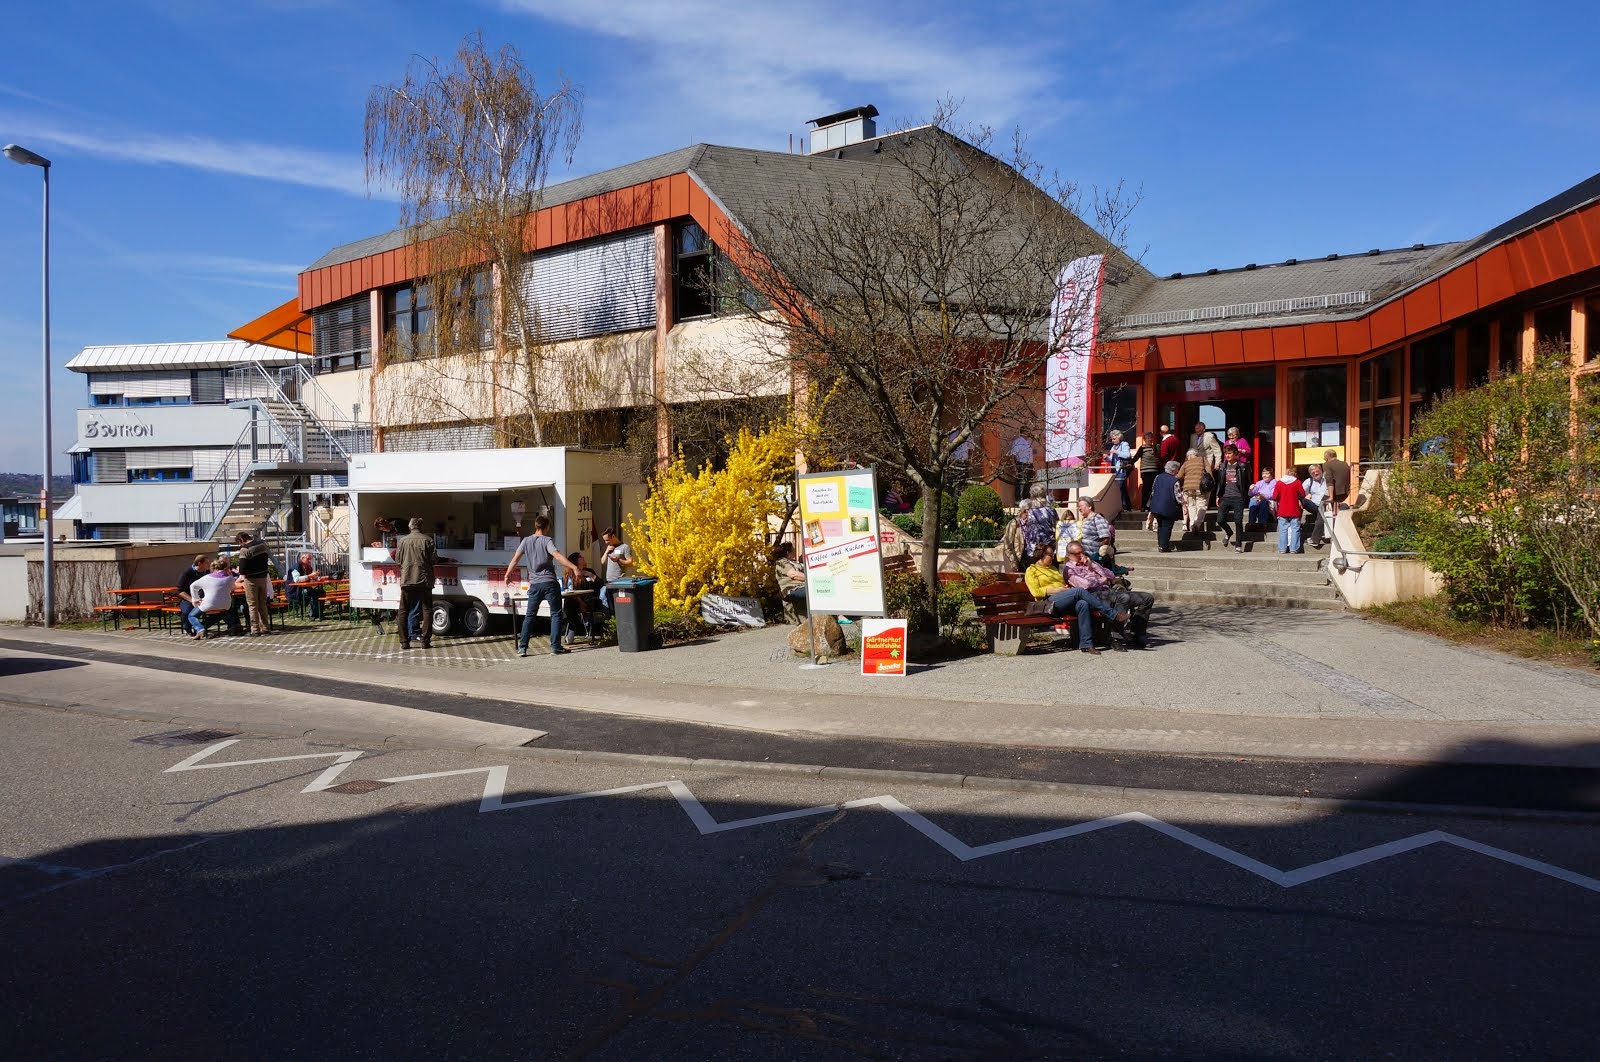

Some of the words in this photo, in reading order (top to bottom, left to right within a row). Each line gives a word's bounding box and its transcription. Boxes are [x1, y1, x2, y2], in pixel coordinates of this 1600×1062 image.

[1054, 375, 1069, 403] der
[102, 424, 153, 437] SUTRON
[1053, 408, 1070, 438] Tag
[810, 553, 828, 562] Kaffee
[831, 549, 842, 557] und
[845, 544, 865, 552] Kuchen
[716, 597, 757, 608] Flohmarkt
[878, 663, 902, 671] demeter
